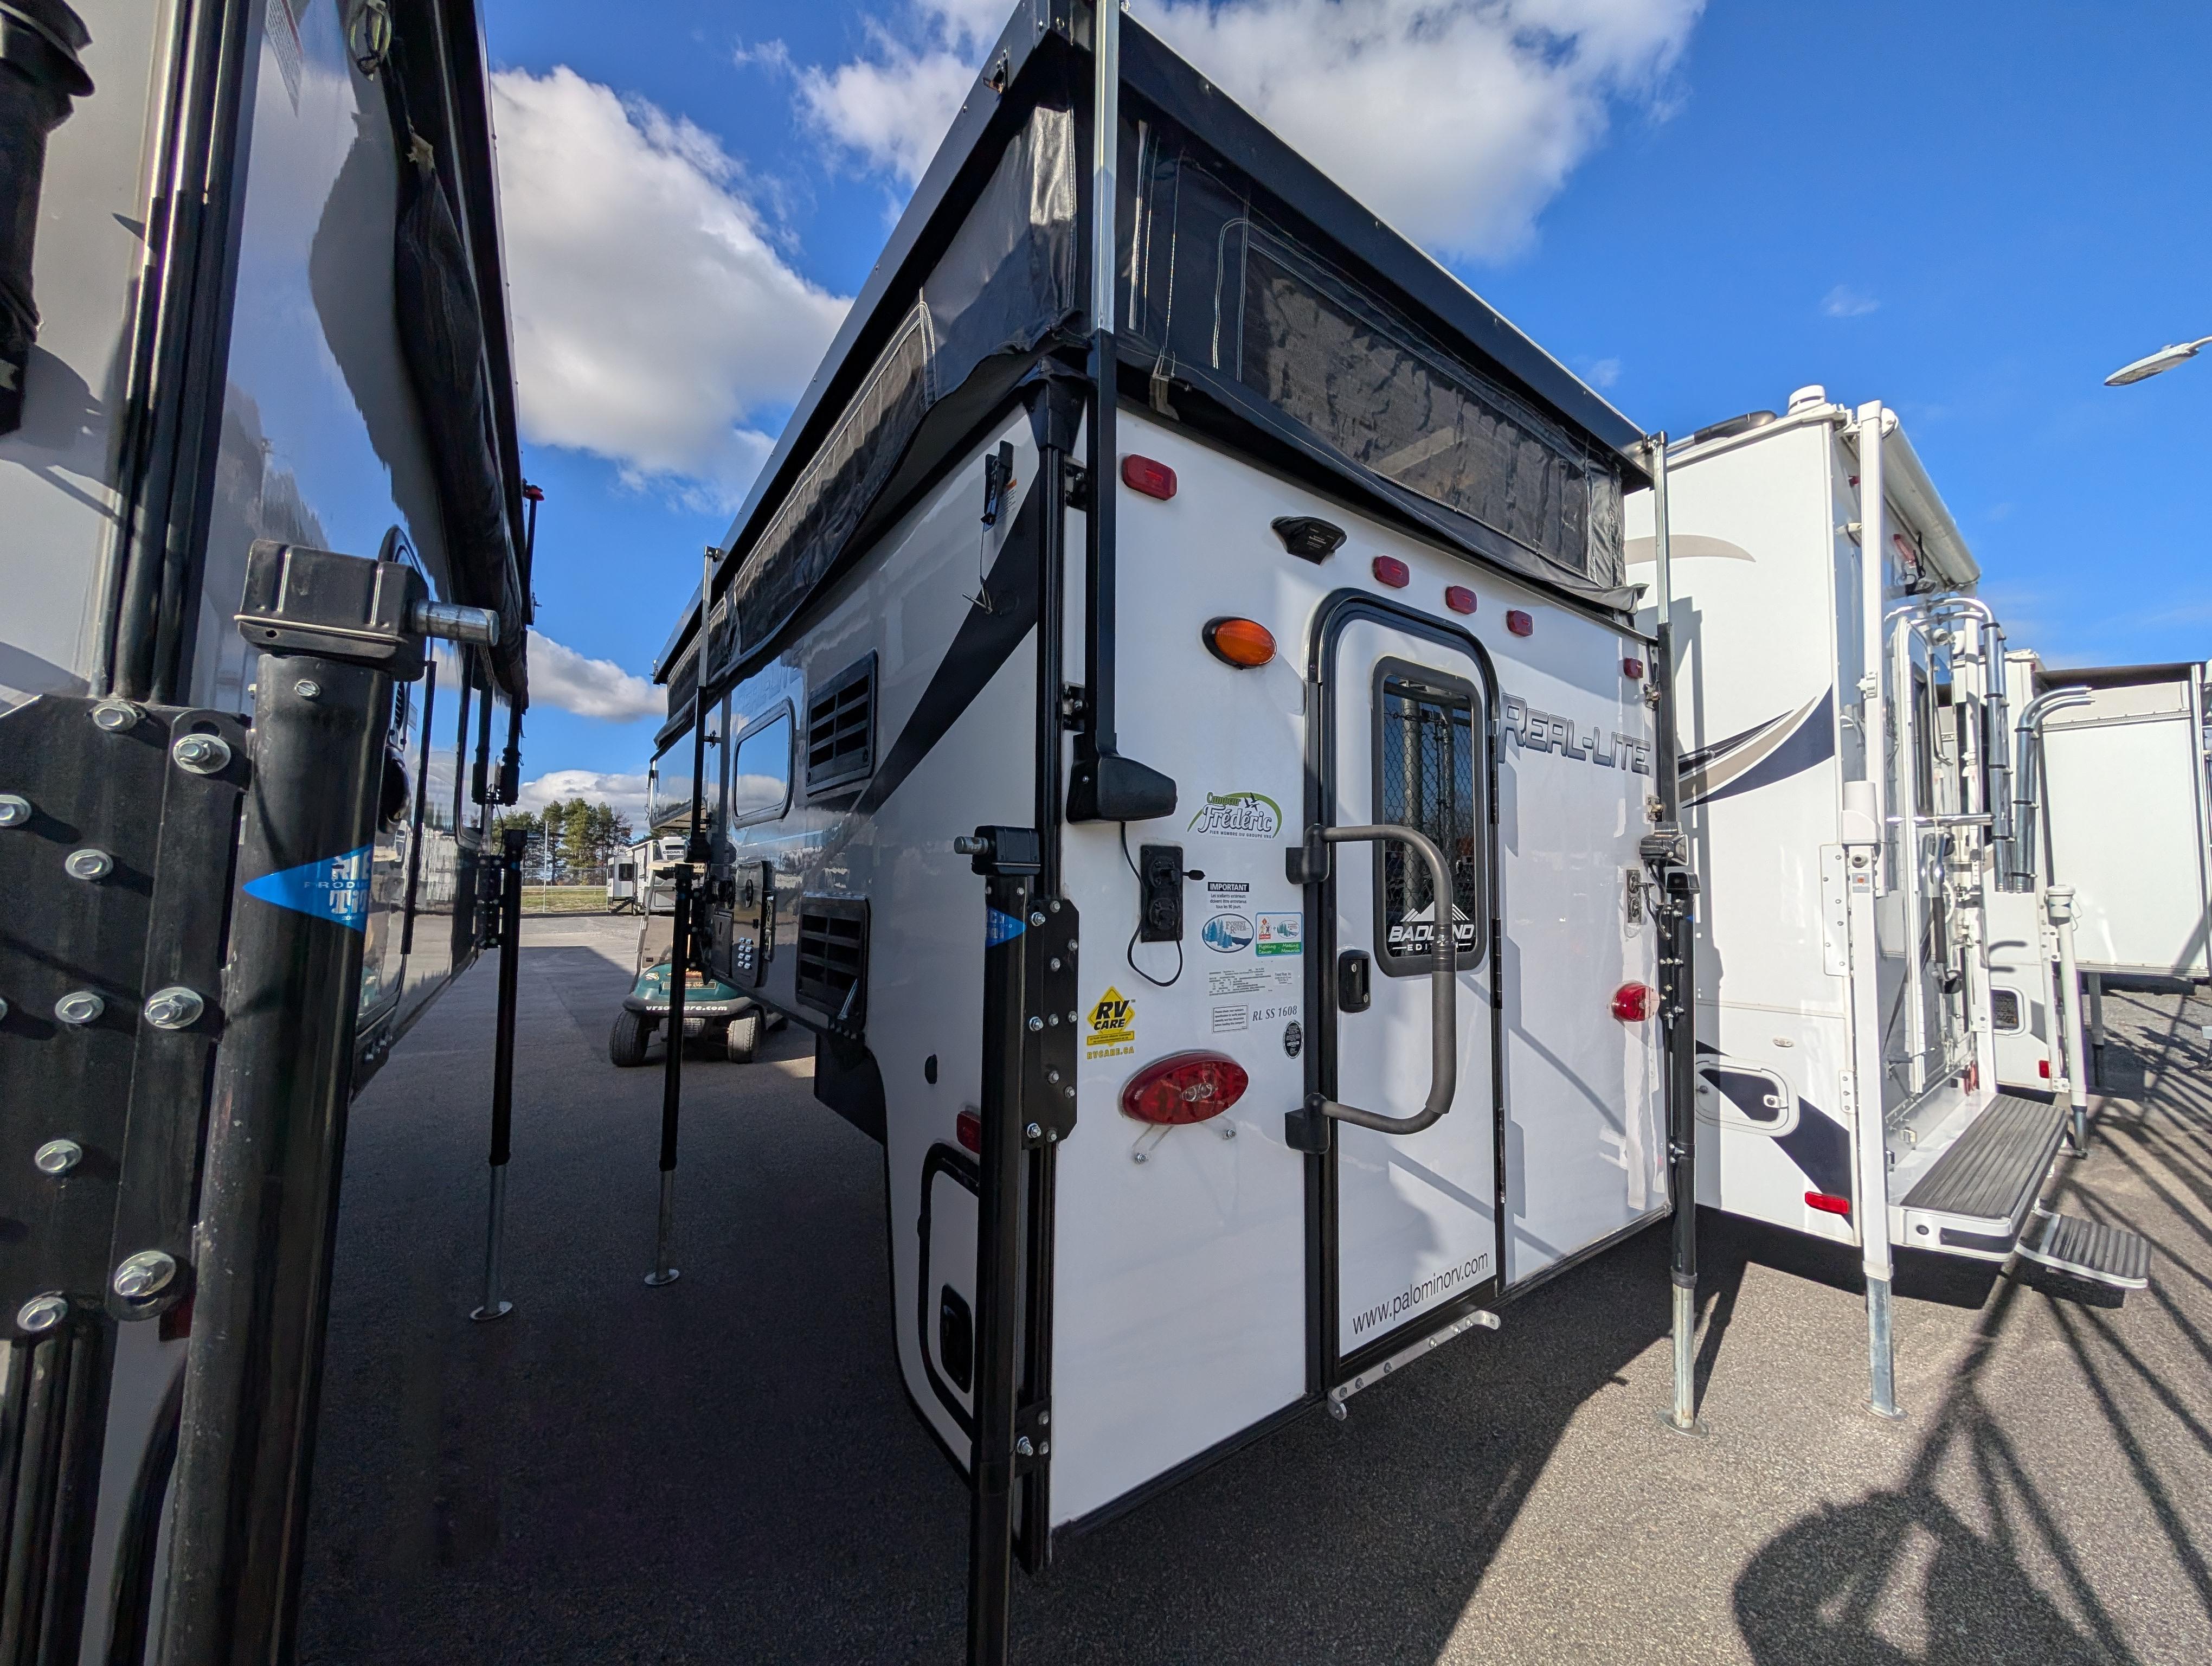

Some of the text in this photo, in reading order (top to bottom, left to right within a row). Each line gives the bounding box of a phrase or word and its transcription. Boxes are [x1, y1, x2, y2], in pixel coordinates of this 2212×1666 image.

[1497, 693, 1650, 776] REAL-LITE
[1207, 792, 1241, 806] Campeur
[1198, 804, 1272, 833] Frédéric
[1210, 883, 1247, 891] IMPORTANT
[1225, 921, 1246, 930] FOREST
[1388, 924, 1475, 943] BADLND
[1096, 1000, 1130, 1020] RV
[1252, 1010, 1263, 1021] RL
[1265, 1008, 1275, 1019] SS
[1278, 1005, 1297, 1017] 1608
[1094, 1018, 1126, 1030] CARE
[1086, 1046, 1135, 1060] RVCARE.CA
[1353, 1253, 1488, 1335] www.palominorv.com
